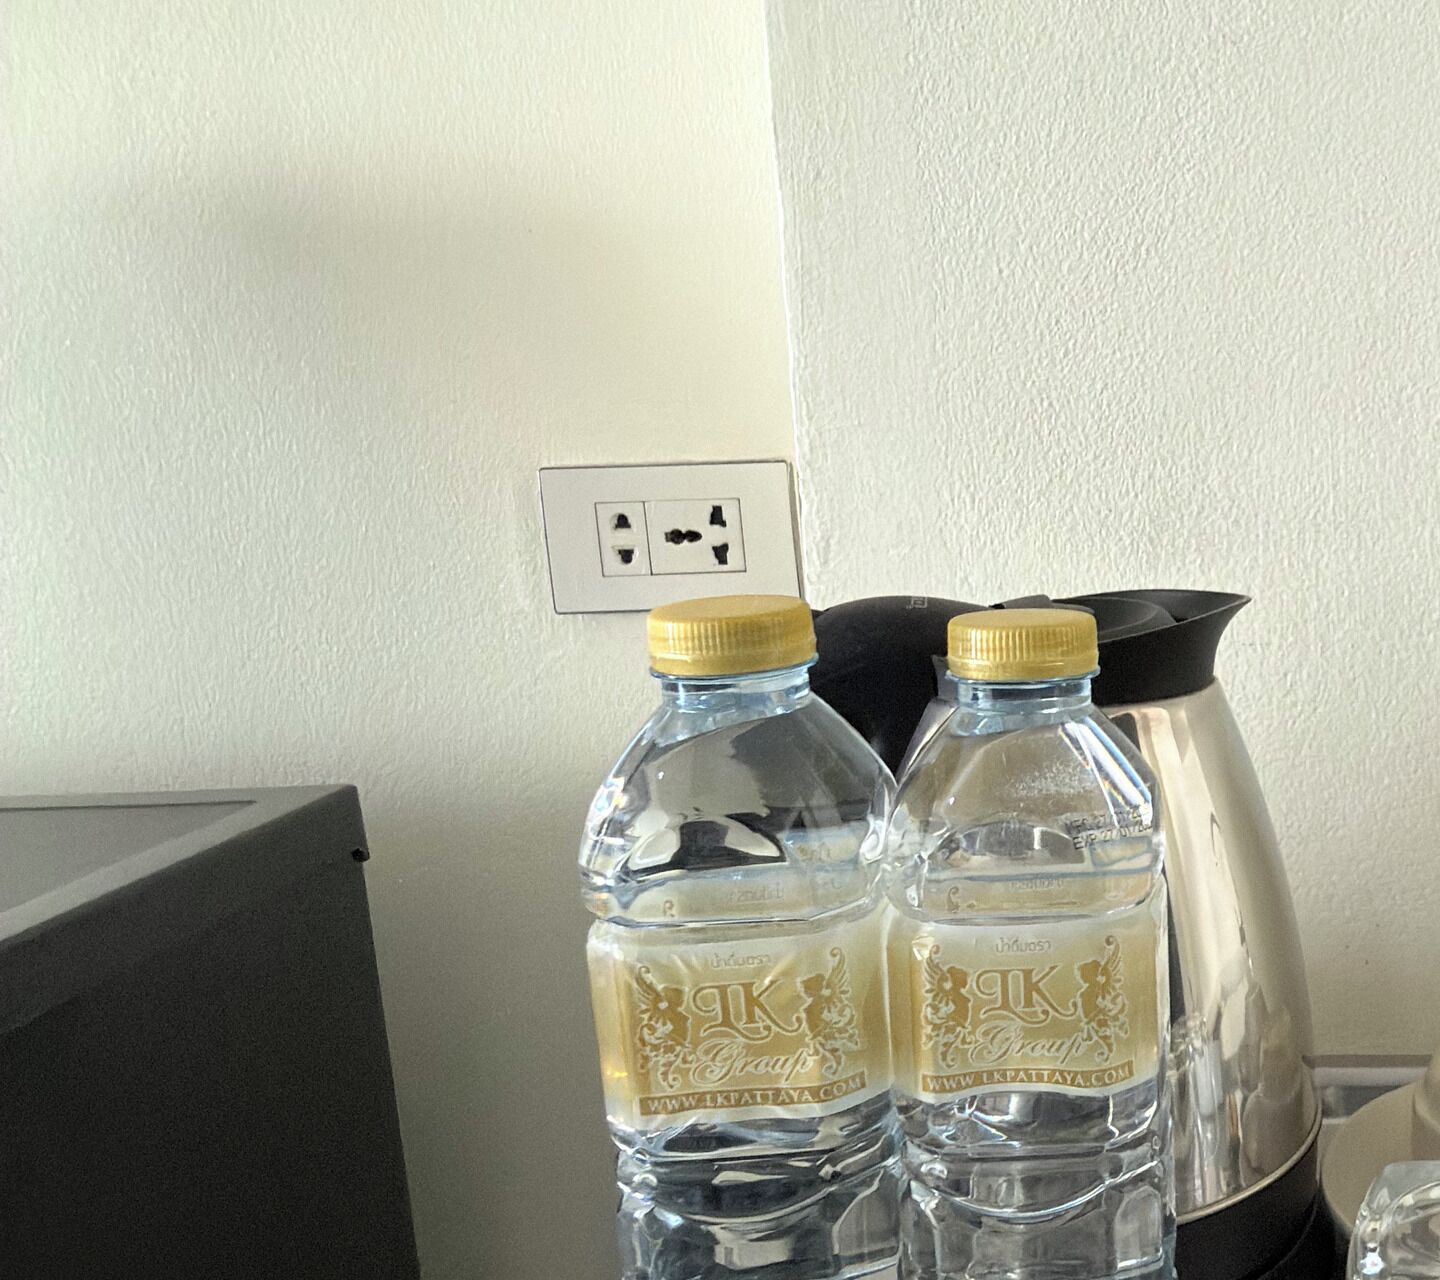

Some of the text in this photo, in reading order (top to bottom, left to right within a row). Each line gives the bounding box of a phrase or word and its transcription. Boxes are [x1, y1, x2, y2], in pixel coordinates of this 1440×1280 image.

[692, 979, 803, 1043] LK
[975, 964, 1078, 1026] LK
[691, 1039, 814, 1086] Group
[969, 1024, 1086, 1065] Group
